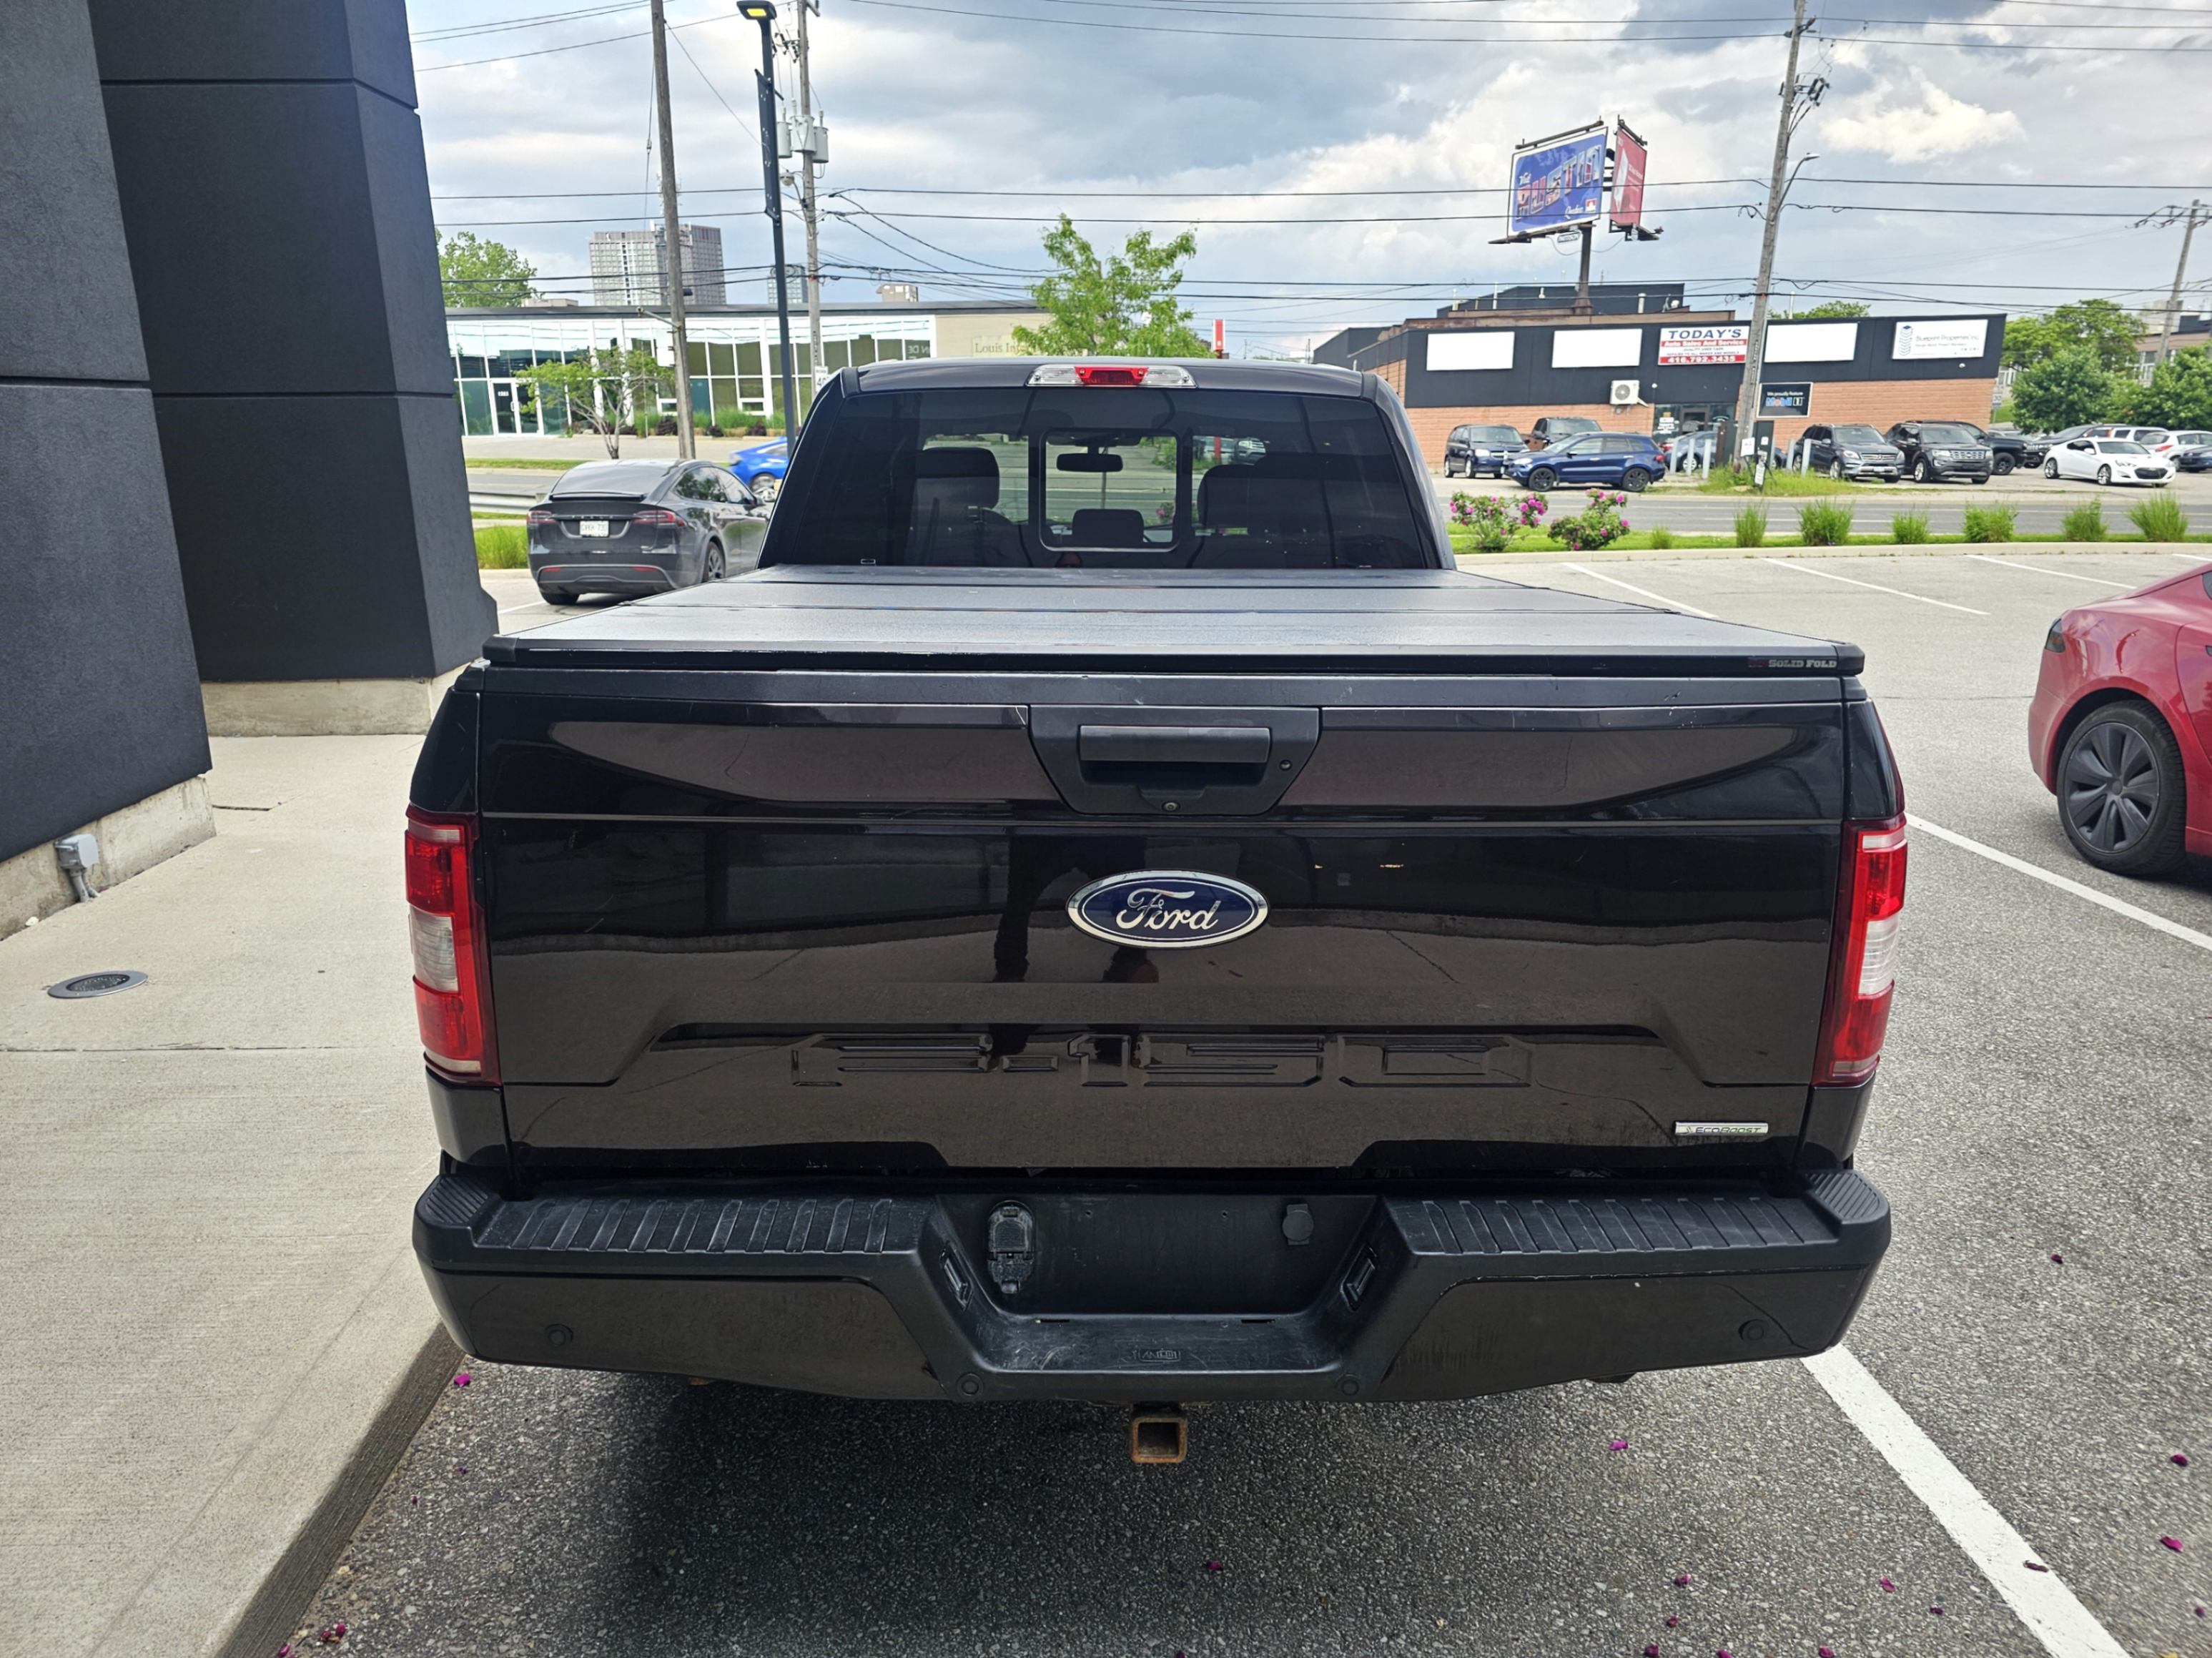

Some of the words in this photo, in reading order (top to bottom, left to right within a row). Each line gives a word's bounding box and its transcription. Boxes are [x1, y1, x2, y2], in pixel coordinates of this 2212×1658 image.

[1668, 329, 1742, 339] TODAY'S
[974, 343, 1002, 353] Louis
[1766, 397, 1792, 406] Mobil
[1769, 659, 1804, 668] SOLID
[1805, 659, 1837, 668] FOLD
[1115, 888, 1219, 930] Ford
